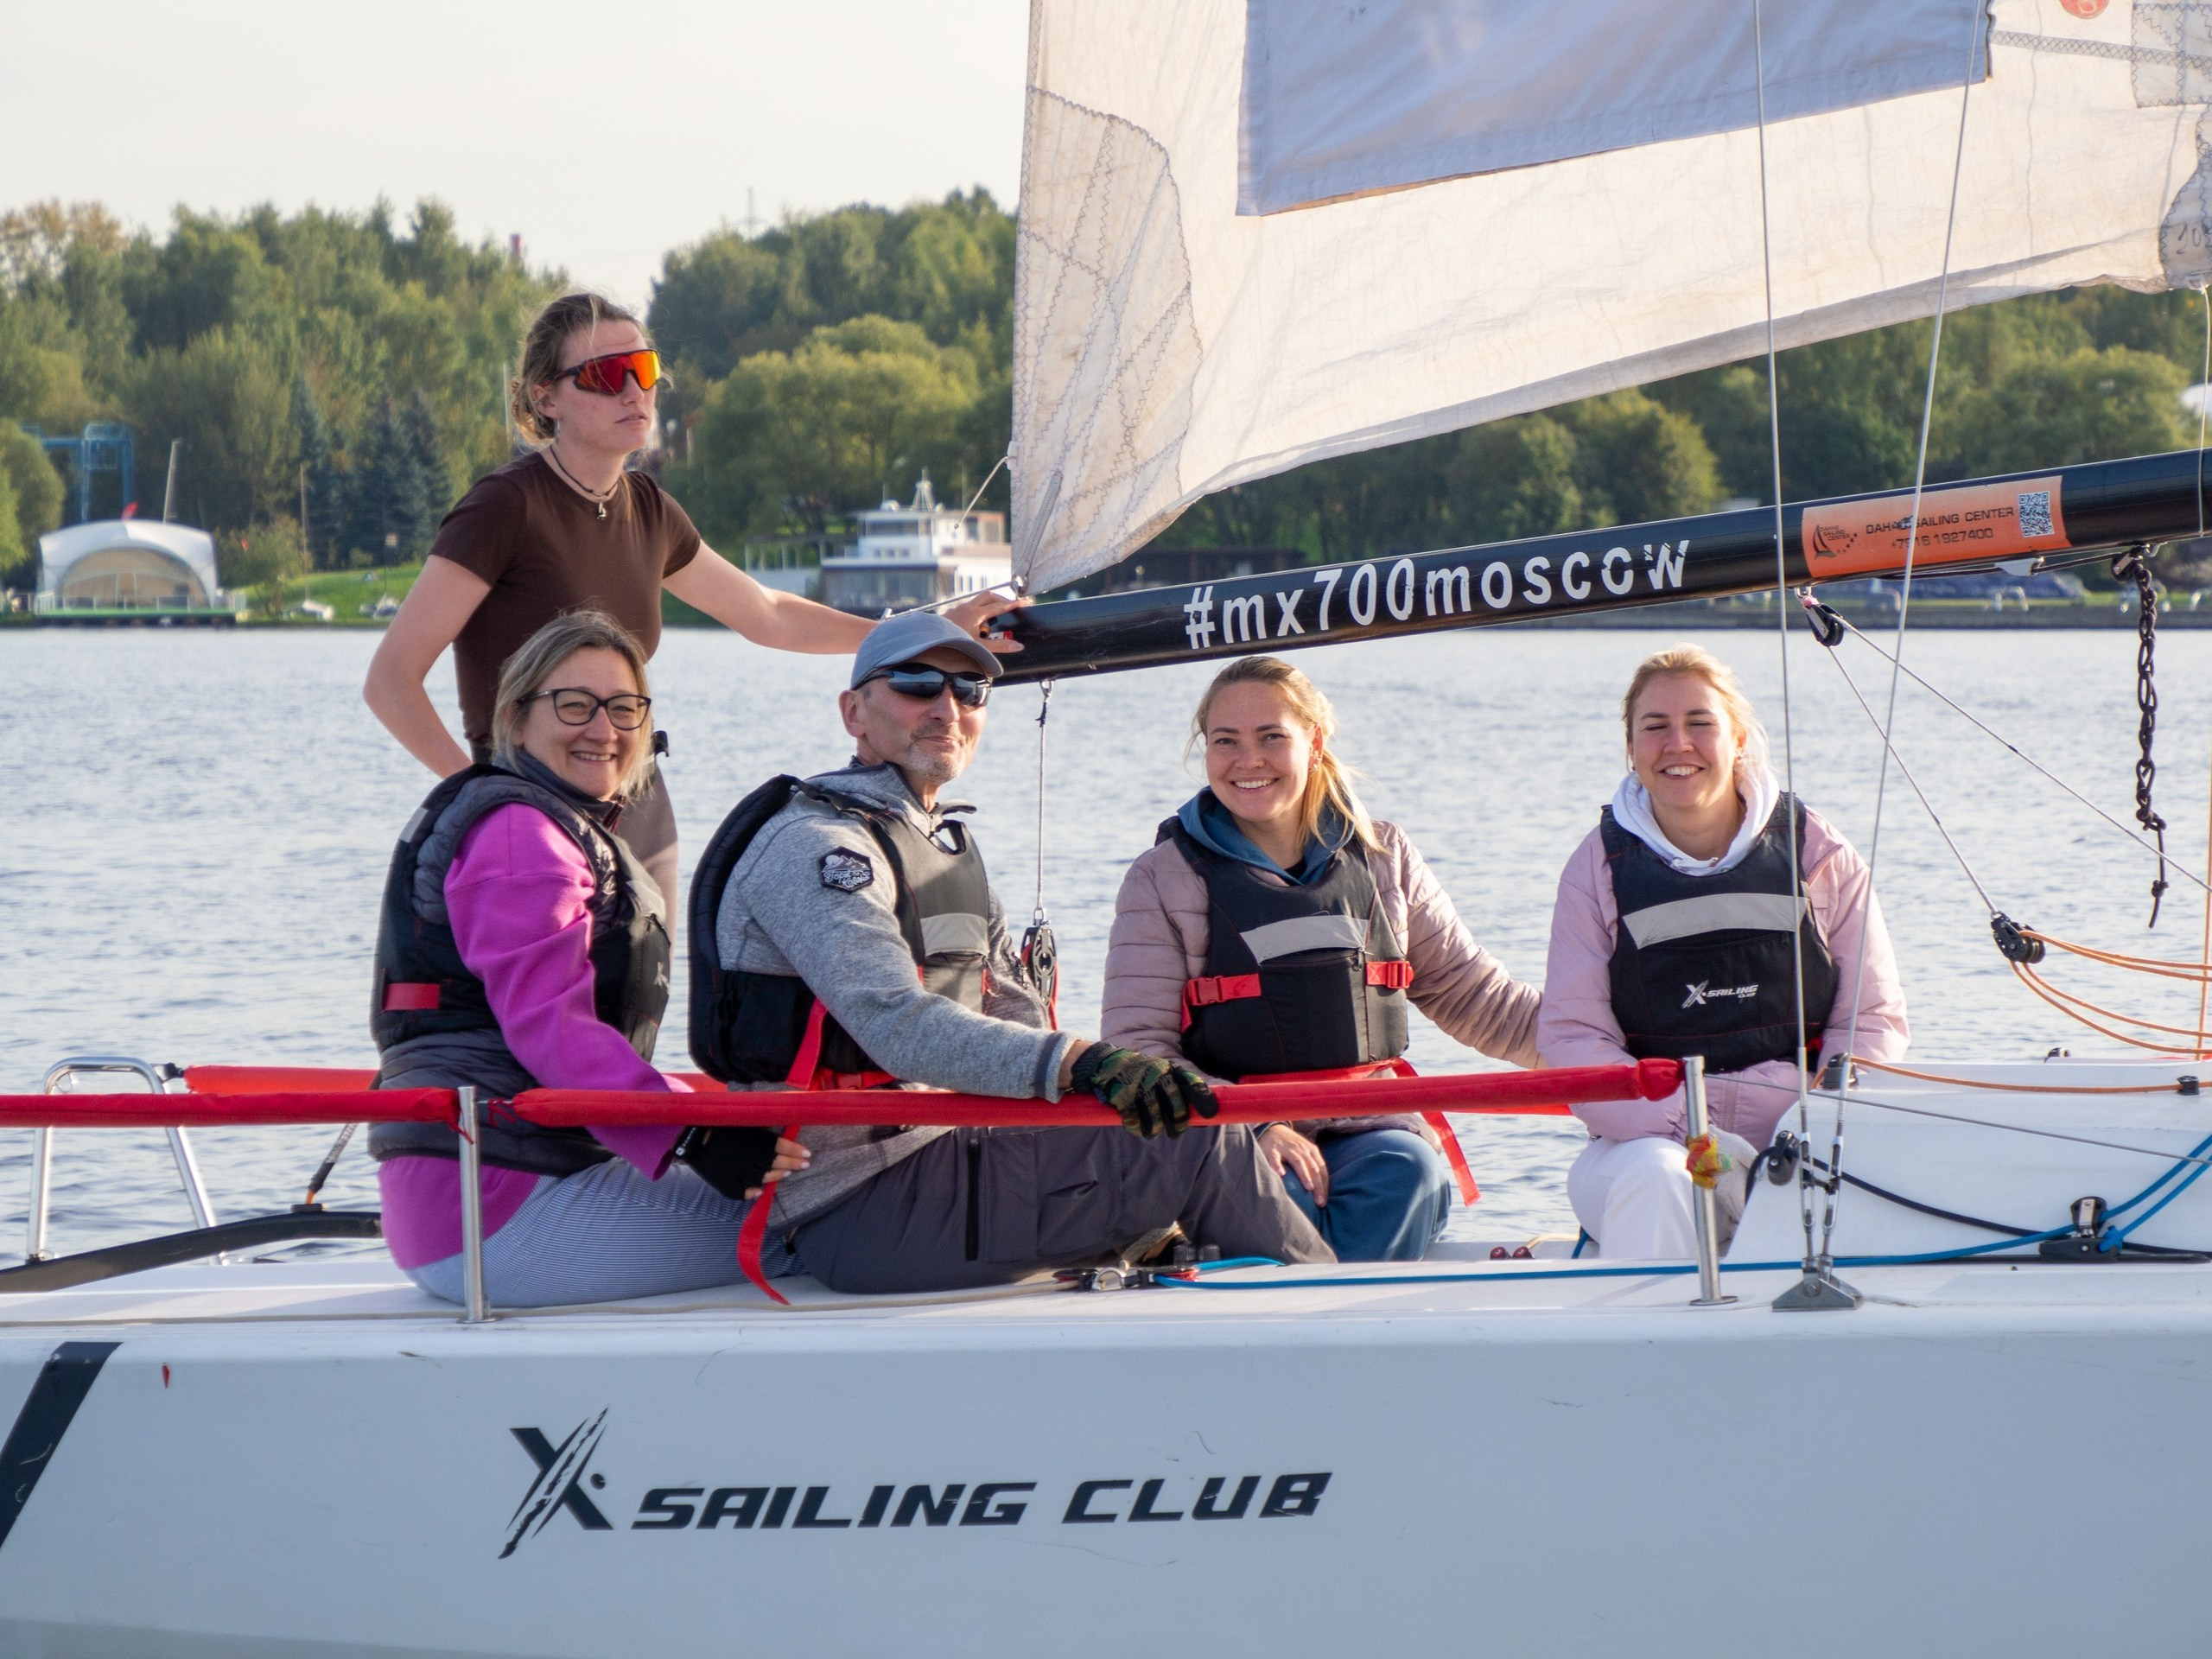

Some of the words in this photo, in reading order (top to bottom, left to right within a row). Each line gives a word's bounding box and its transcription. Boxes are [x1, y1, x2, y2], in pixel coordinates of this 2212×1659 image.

[1965, 507, 2013, 521] CENTER
[1934, 528, 1993, 544] 1927400
[1184, 540, 1689, 650] #mx700moscow
[1707, 984, 1759, 998] SAILING
[631, 1480, 1038, 1530] SAILING
[1062, 1471, 1332, 1524] CLUB
